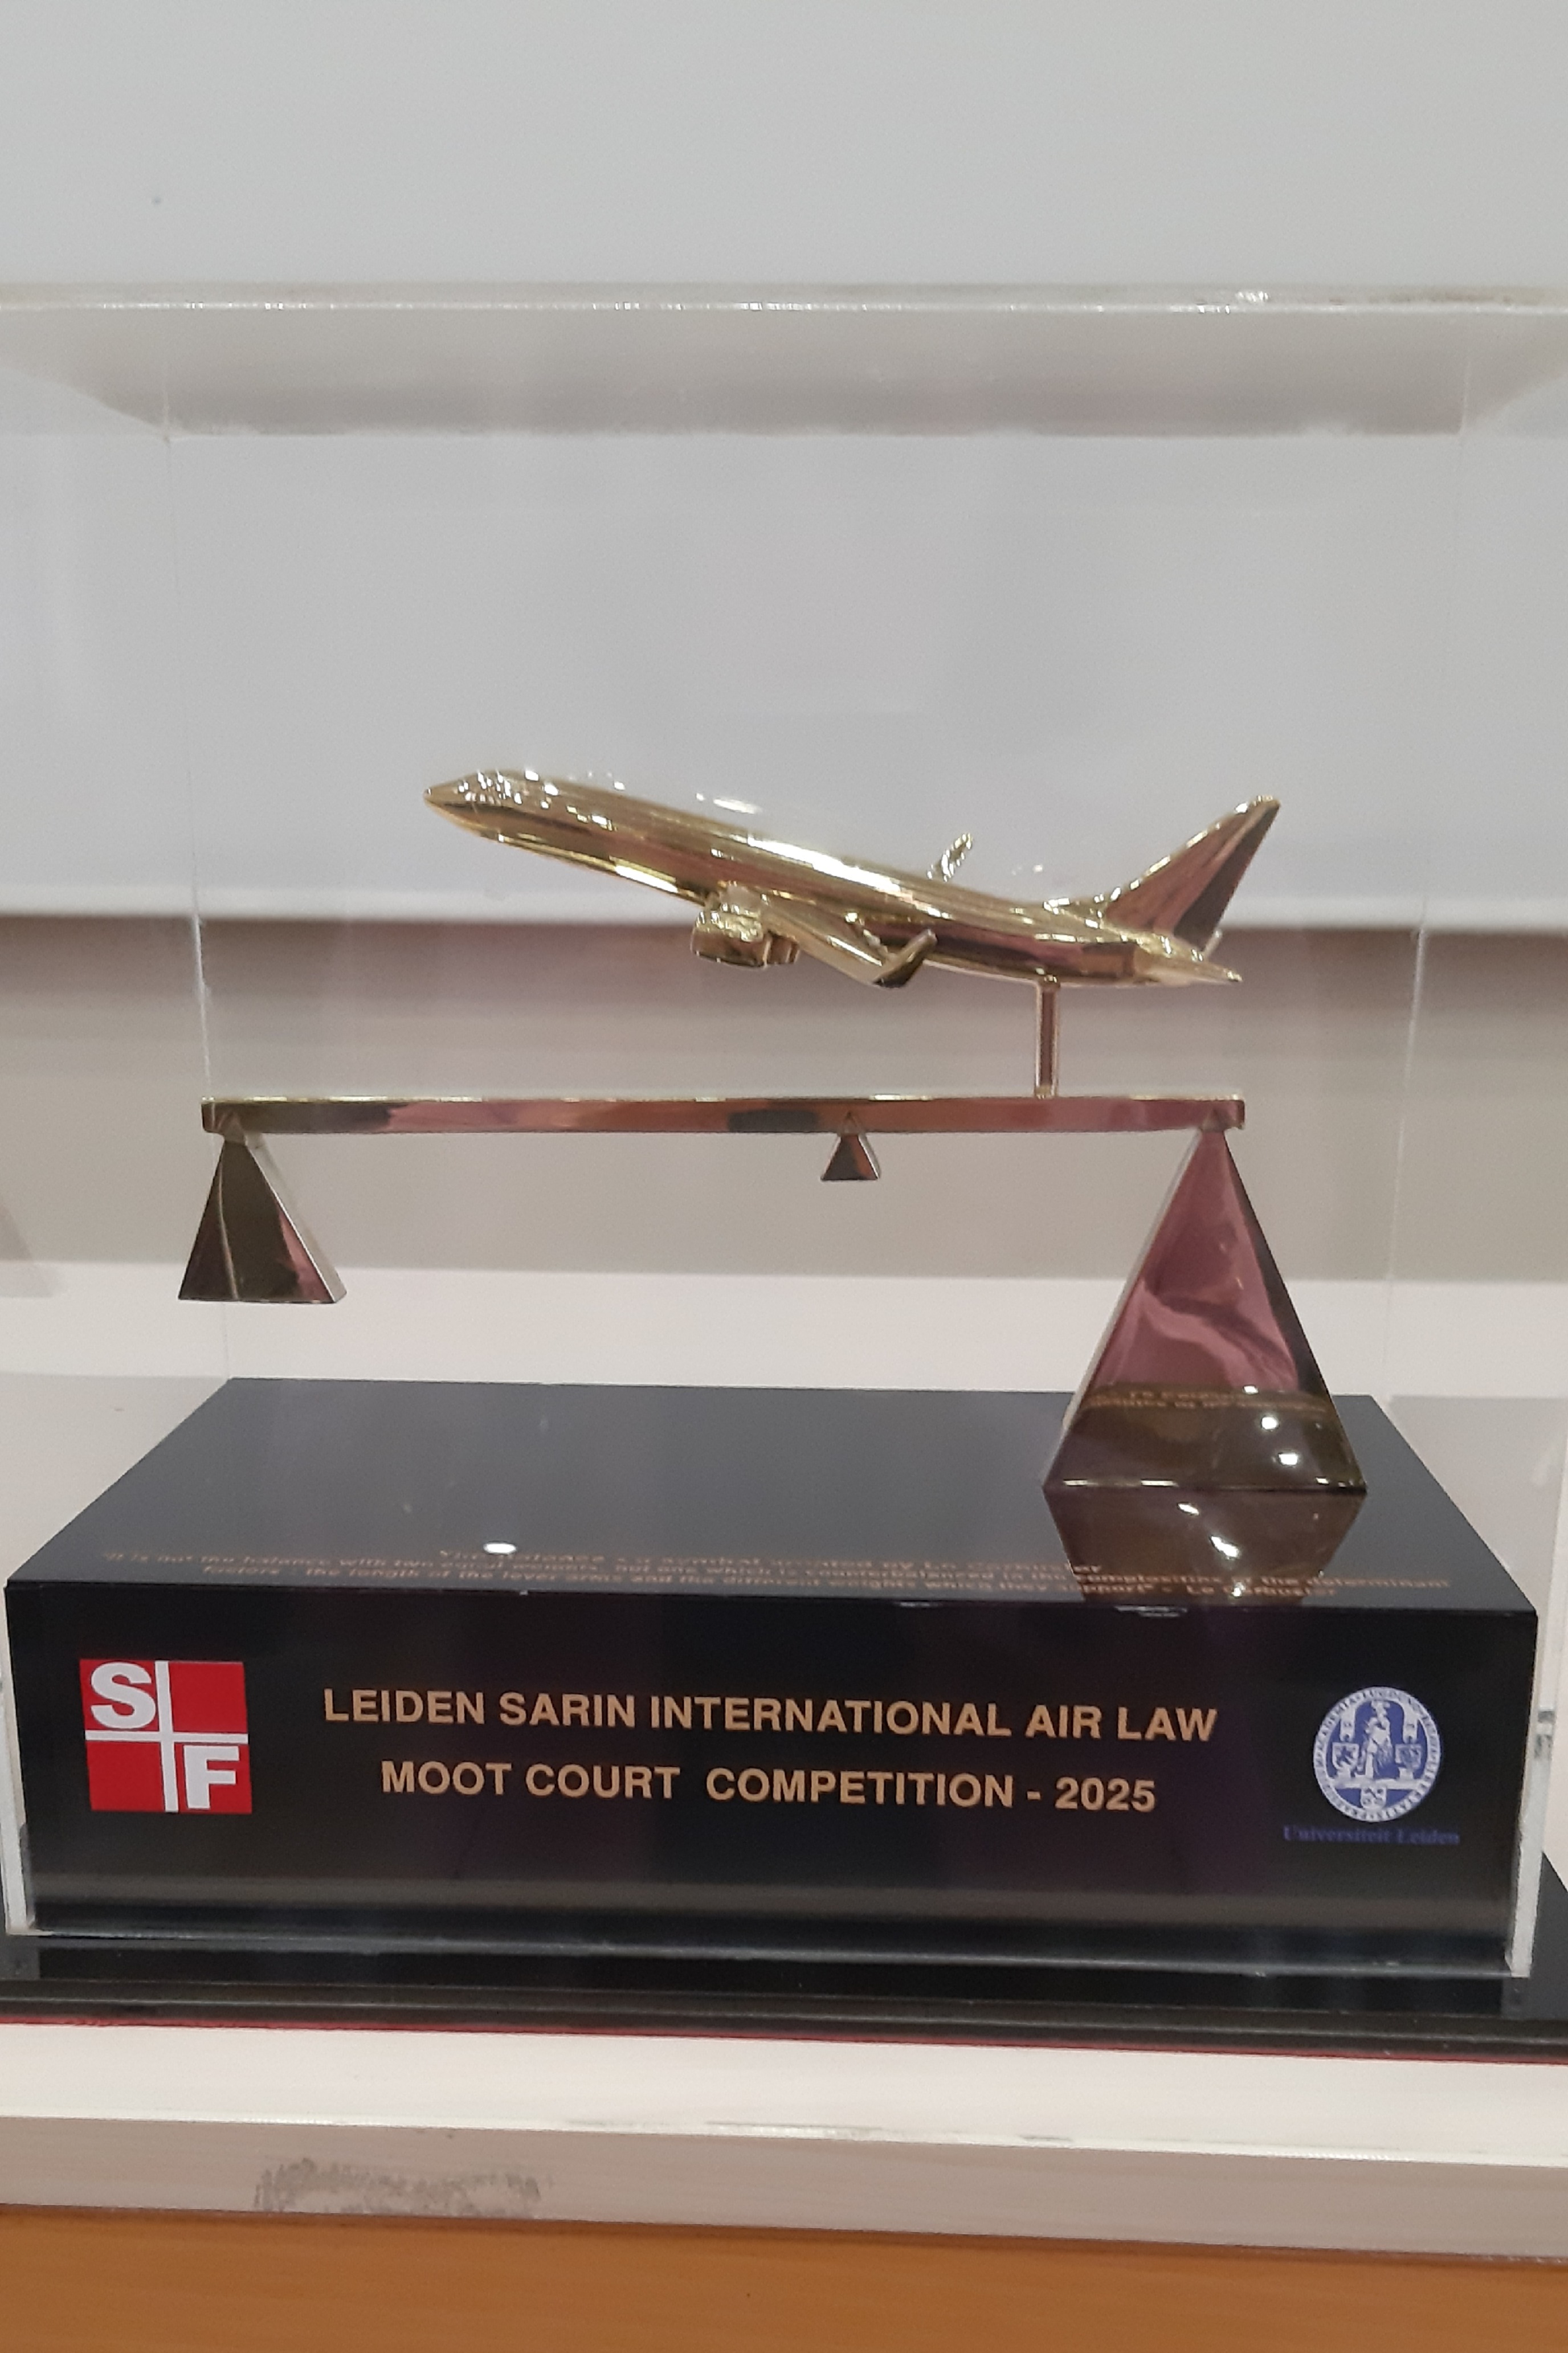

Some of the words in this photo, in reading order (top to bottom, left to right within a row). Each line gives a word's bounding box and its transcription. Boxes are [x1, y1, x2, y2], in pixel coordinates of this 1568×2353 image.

[324, 1688, 485, 1724] LEIDEN
[499, 1692, 635, 1727] SARIN
[651, 1696, 1012, 1737] INTERNATIONAL
[1025, 1705, 1102, 1739] AIR
[1117, 1706, 1218, 1742] LAW
[381, 1760, 512, 1795] MOOT
[525, 1763, 680, 1799] COURT
[706, 1767, 1014, 1808] COMPETITION
[1055, 1776, 1155, 1812] 2025
